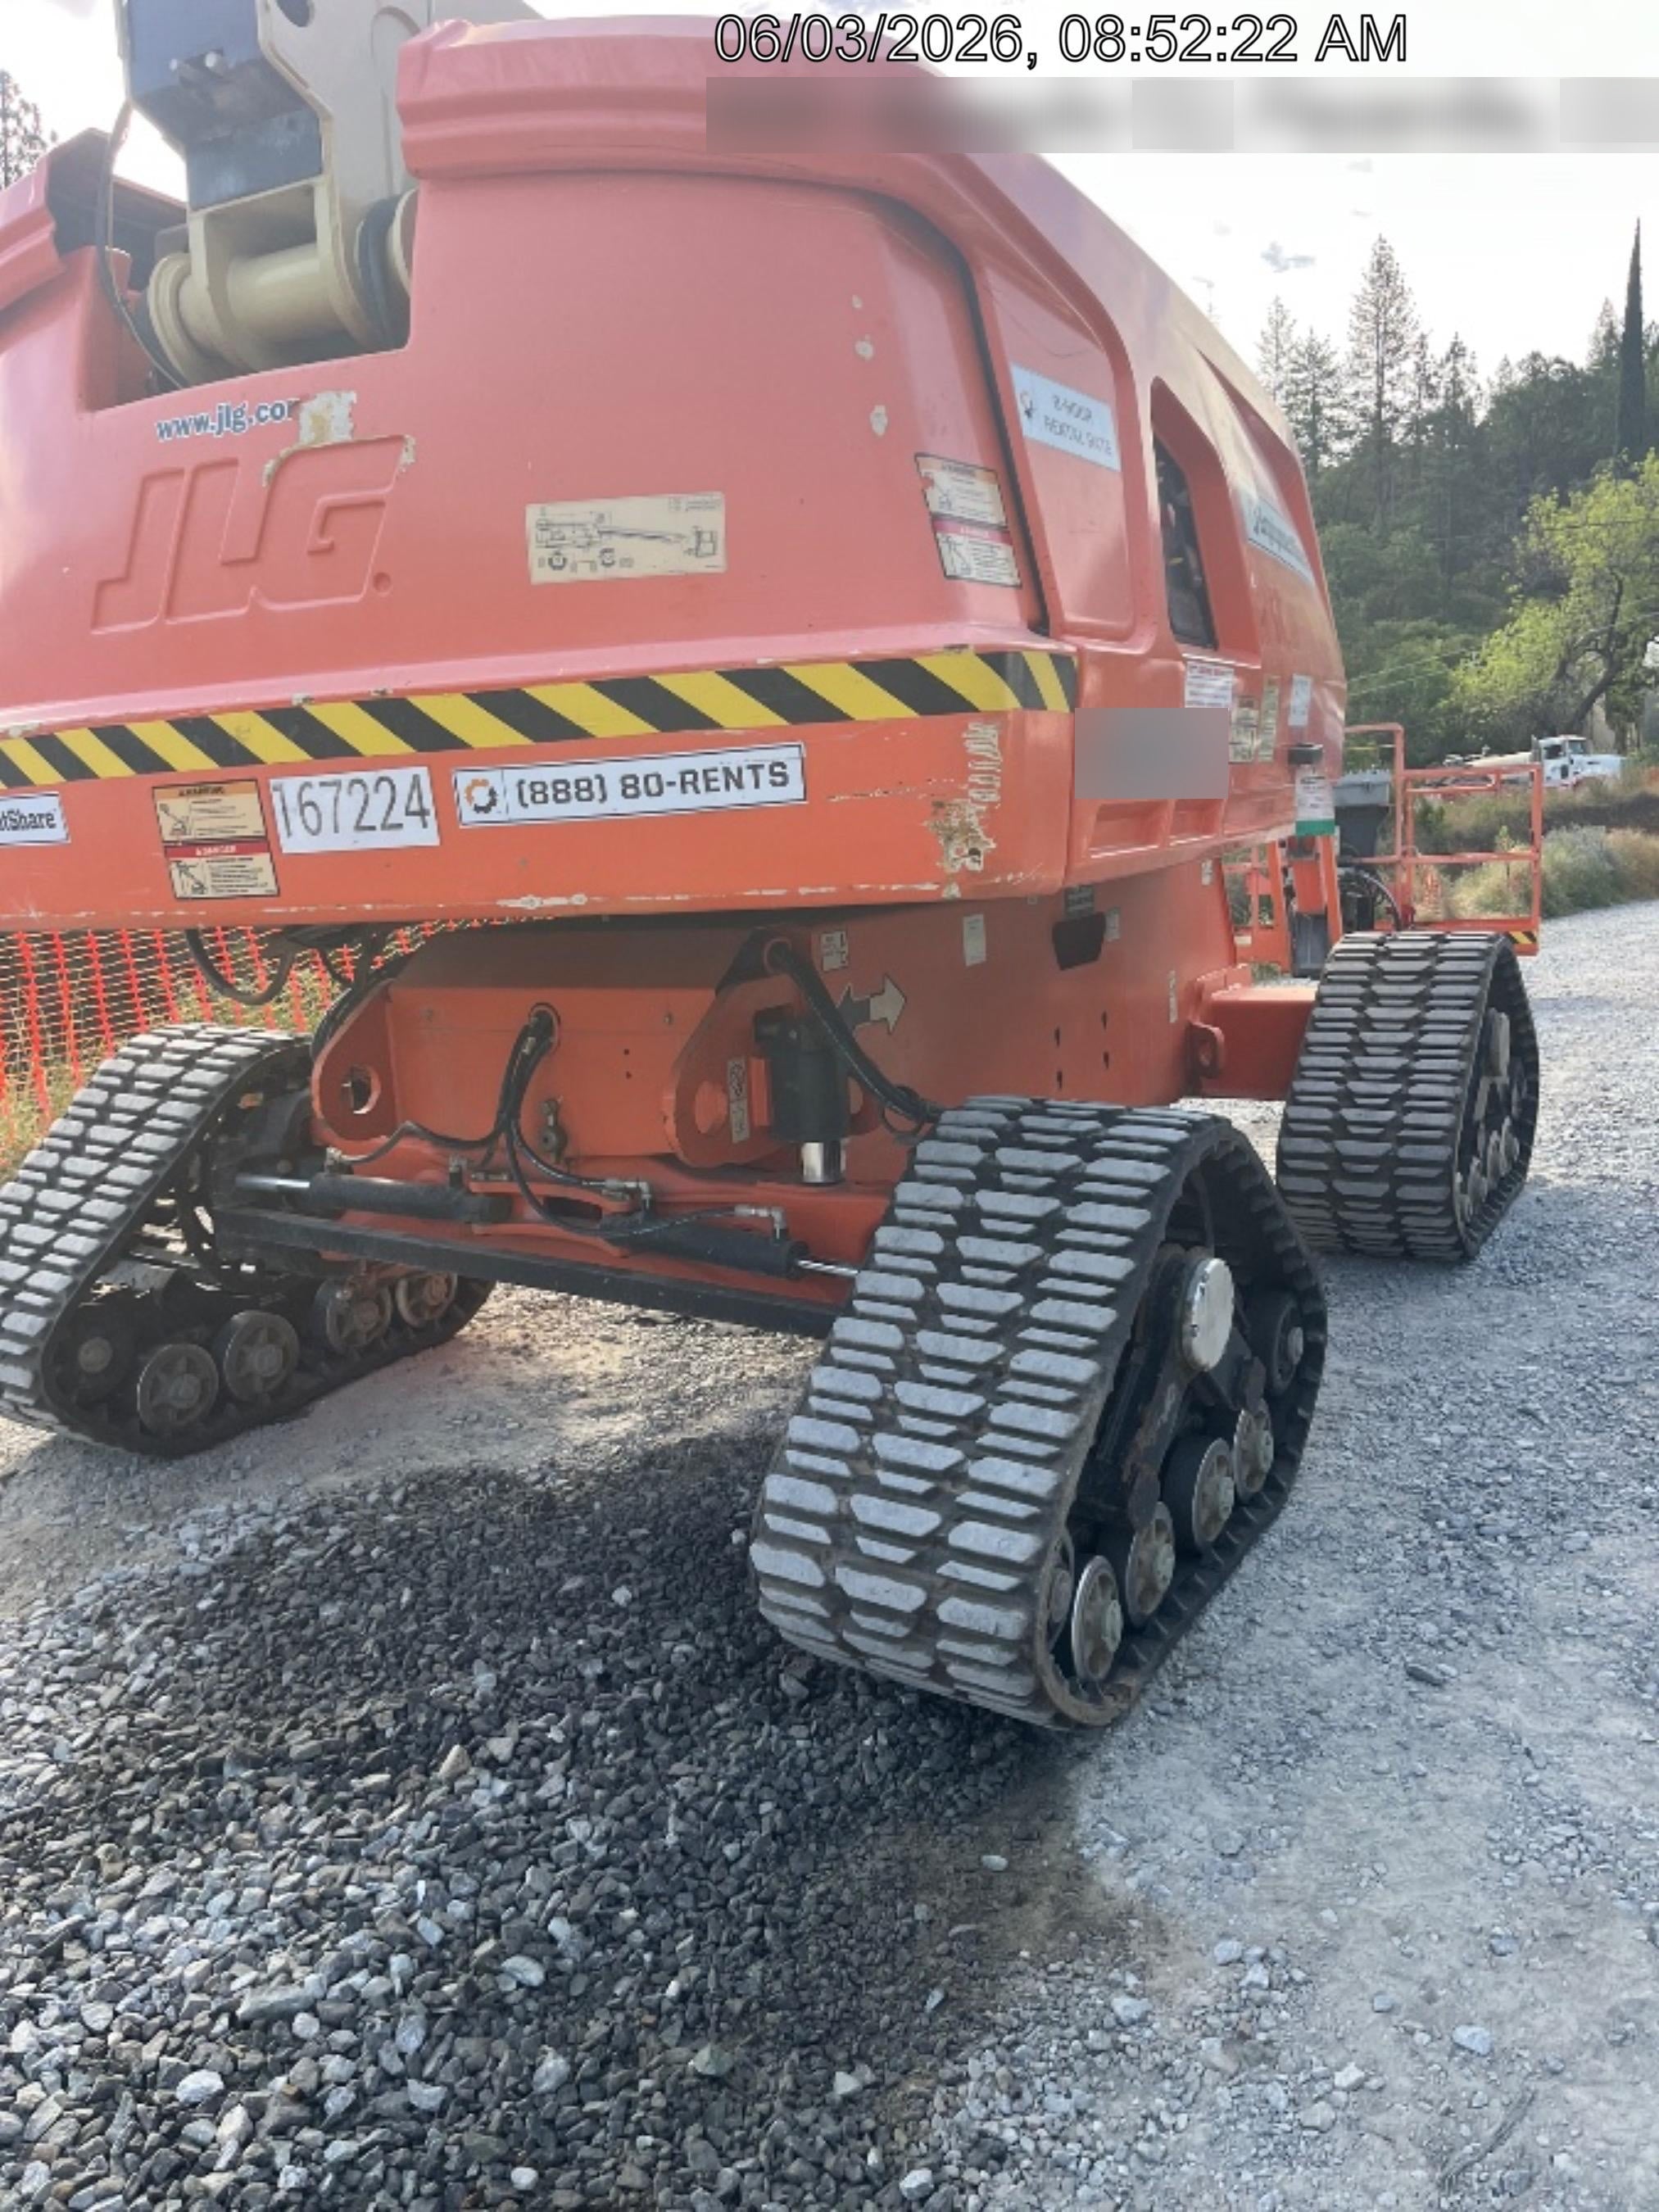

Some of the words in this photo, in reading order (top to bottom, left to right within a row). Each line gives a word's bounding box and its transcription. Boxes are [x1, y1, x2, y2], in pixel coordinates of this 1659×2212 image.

[90, 434, 410, 635] JLG
[272, 773, 431, 838] 167224
[516, 773, 608, 809] (888)
[619, 761, 790, 800] 80-RENTS
[0, 809, 57, 832] tShare
